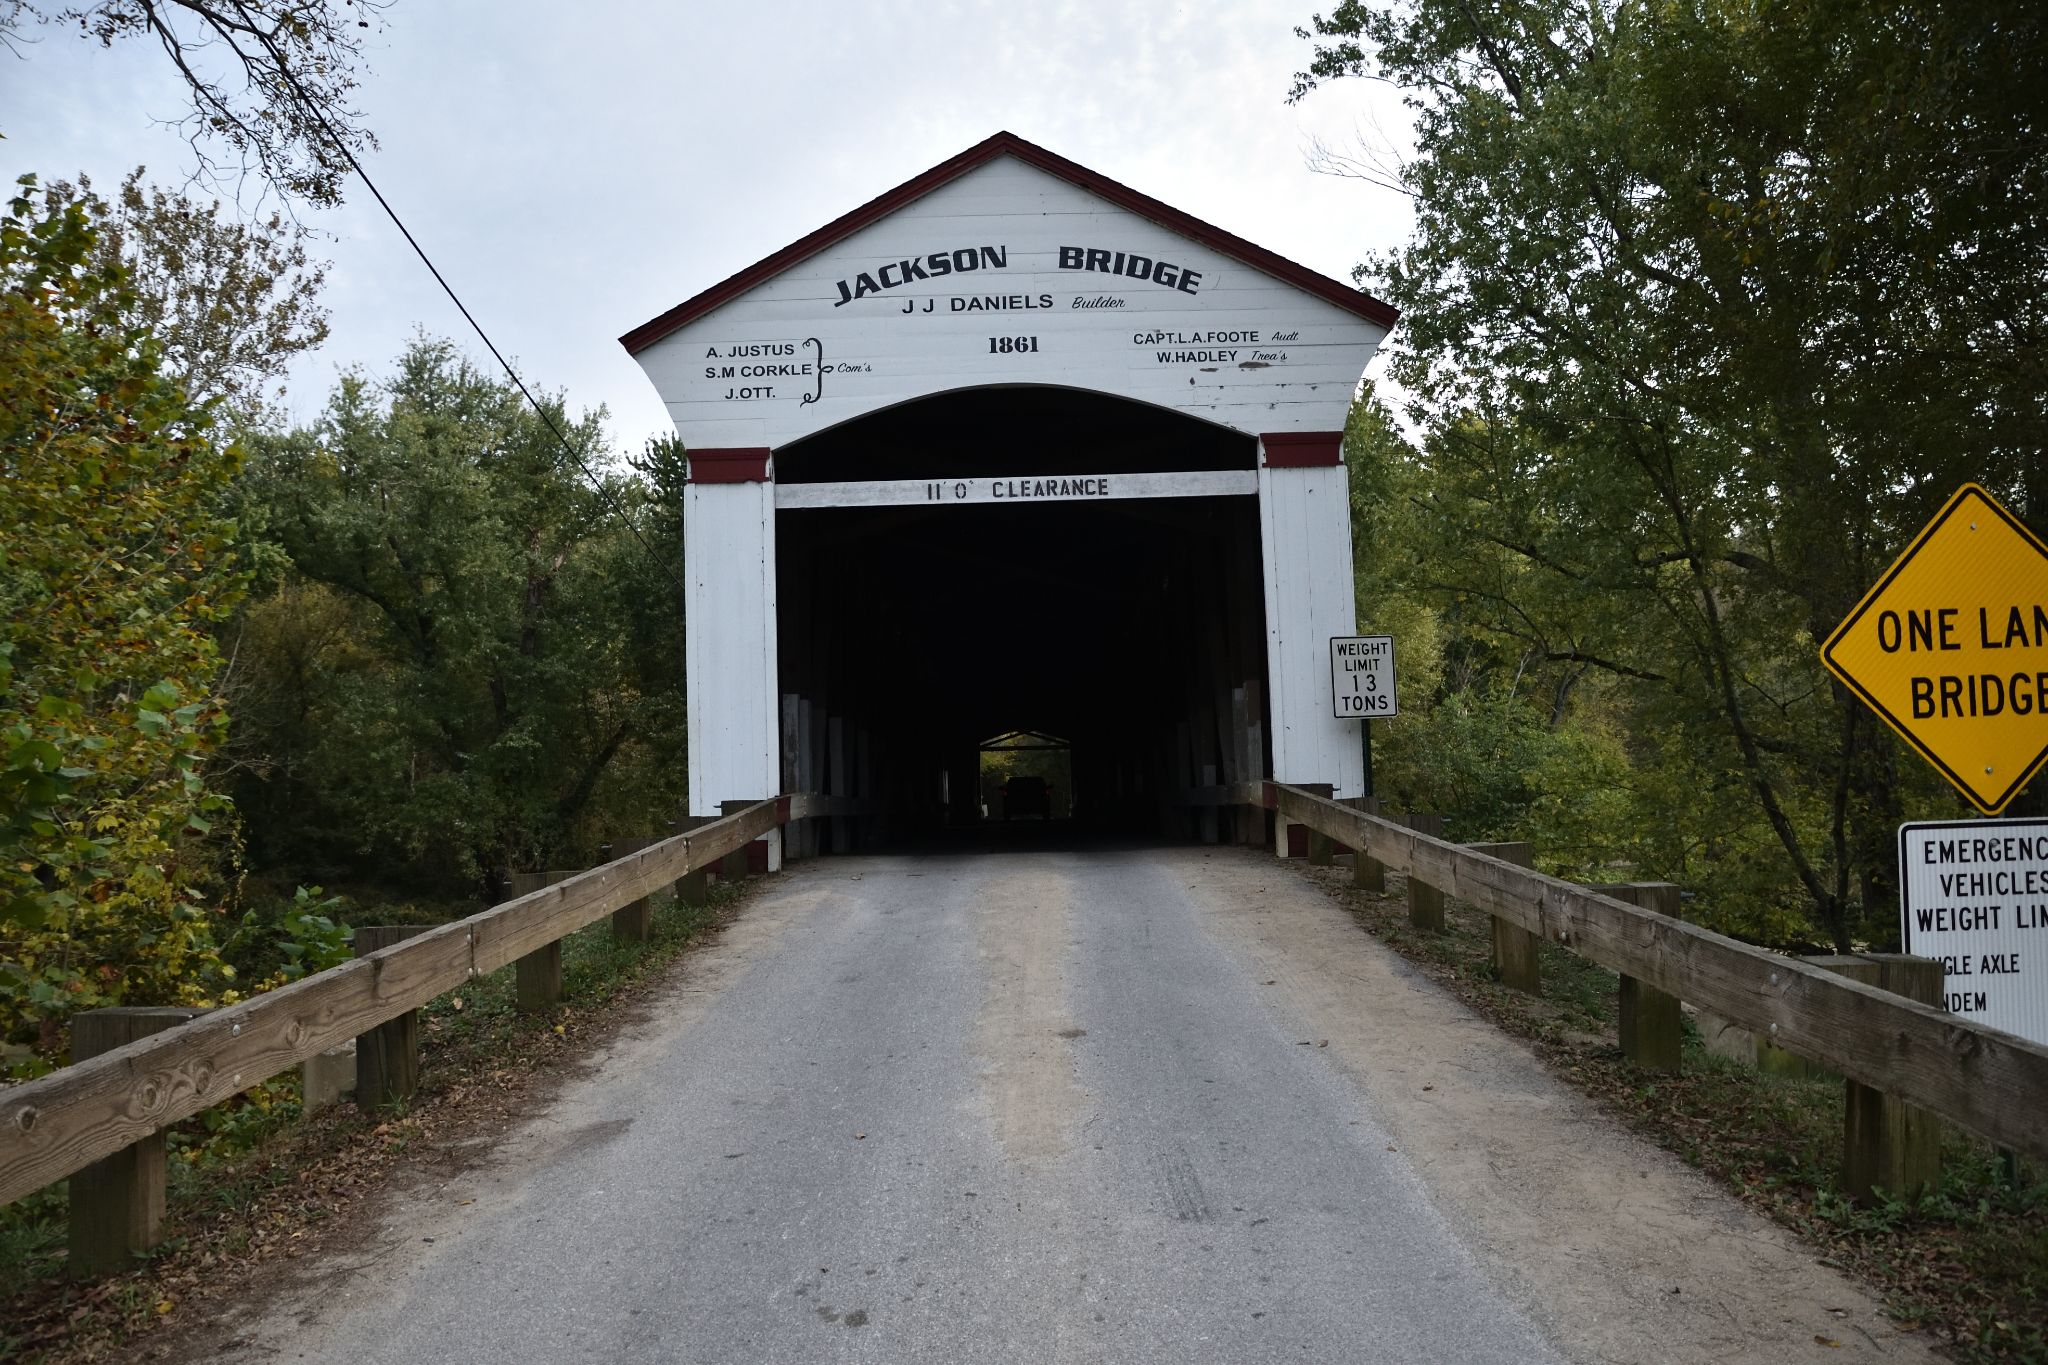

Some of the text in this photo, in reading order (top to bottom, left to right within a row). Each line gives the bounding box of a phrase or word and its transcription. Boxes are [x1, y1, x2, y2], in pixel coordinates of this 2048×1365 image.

[834, 245, 1203, 308] JACKSON BRIDGE
[902, 294, 1126, 314] J J DANIELS Builder
[988, 336, 1039, 354] 1861
[1133, 331, 1260, 345] CAPT.L.A.FOOTE
[706, 343, 795, 359] A. JUSTUS
[1156, 350, 1238, 364] W.HADLEY
[705, 364, 812, 379] S.M CORKLE
[837, 362, 873, 374] Com's
[725, 386, 776, 400] J.OTT.
[992, 478, 1109, 498] CLEARANCE
[1877, 608, 1961, 653] ONE
[1337, 642, 1388, 656] WEIGHT
[1345, 658, 1380, 671] LIMIT
[1352, 674, 1377, 692] 13
[1341, 695, 1388, 711] TONS
[1911, 672, 2048, 719] BRIDGE
[1940, 870, 2048, 897] VEHICLES
[1916, 905, 2001, 932] WEIGHT
[1980, 953, 2020, 975] AXLE
